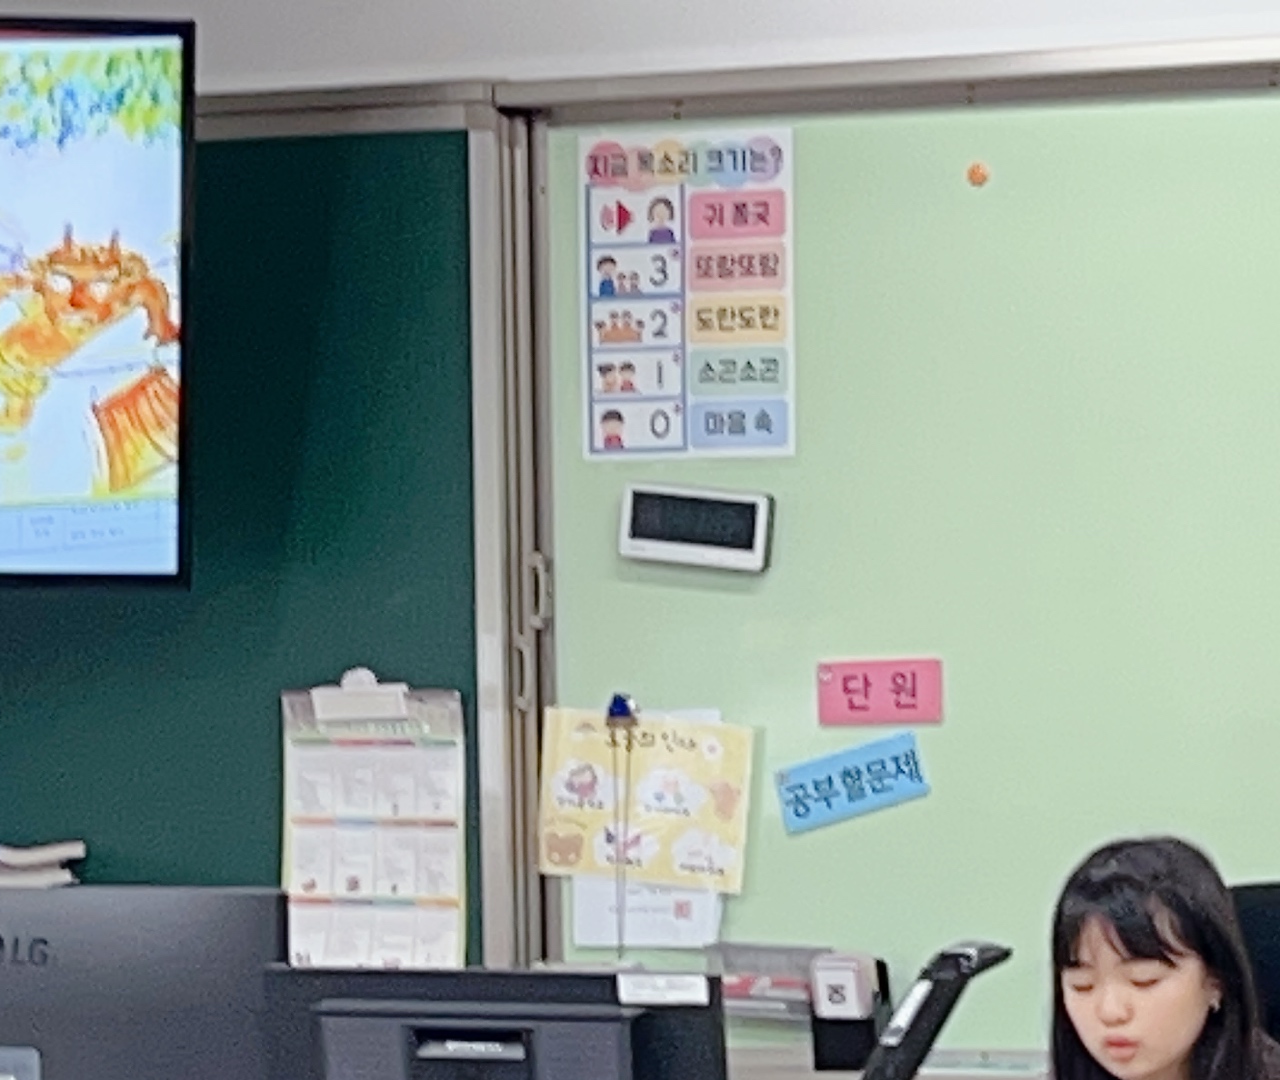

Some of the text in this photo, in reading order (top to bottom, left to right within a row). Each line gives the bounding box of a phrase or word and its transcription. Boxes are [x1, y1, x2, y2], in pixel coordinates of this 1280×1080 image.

[589, 146, 782, 178] 지금 목소리 크기는?
[702, 203, 724, 227] 귀
[649, 254, 669, 287] 3
[695, 252, 780, 280] 또랑또랑
[650, 309, 668, 338] 2
[695, 305, 780, 332] 도란도란
[655, 360, 664, 390] 1
[698, 357, 780, 384] 소곤소곤
[650, 408, 670, 439] 0
[704, 407, 773, 436] 마음 속
[10, 936, 50, 966] LG
